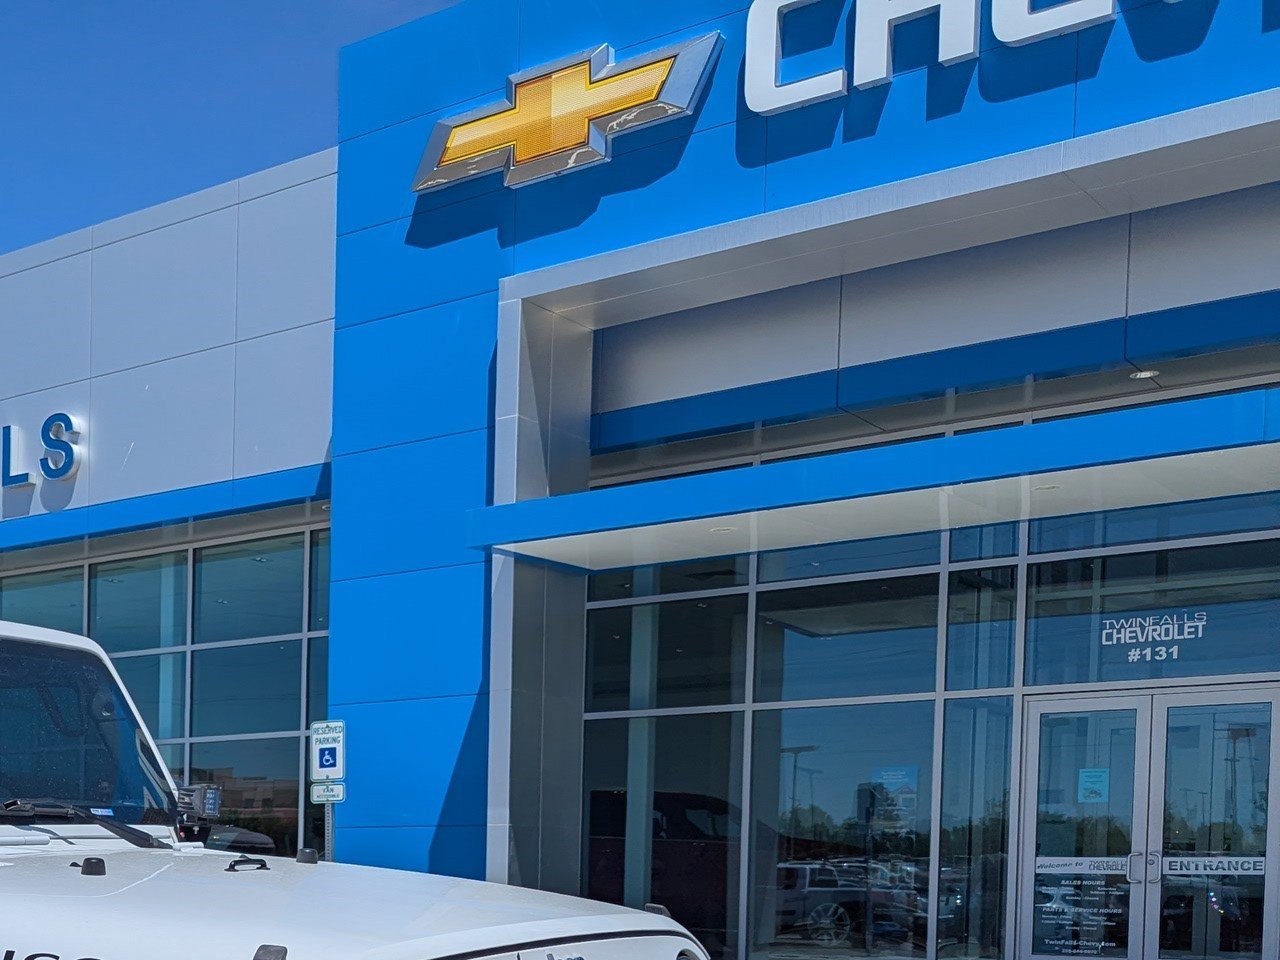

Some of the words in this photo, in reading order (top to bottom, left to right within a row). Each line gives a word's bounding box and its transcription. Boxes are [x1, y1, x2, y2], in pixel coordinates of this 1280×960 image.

[1102, 612, 1207, 630] TWINFALLS
[1101, 621, 1207, 645] CHEVROLET
[1127, 645, 1179, 663] #131
[313, 725, 343, 736] RESERVED
[314, 736, 341, 746] PARKING
[1168, 860, 1264, 872] ENTRANCE
